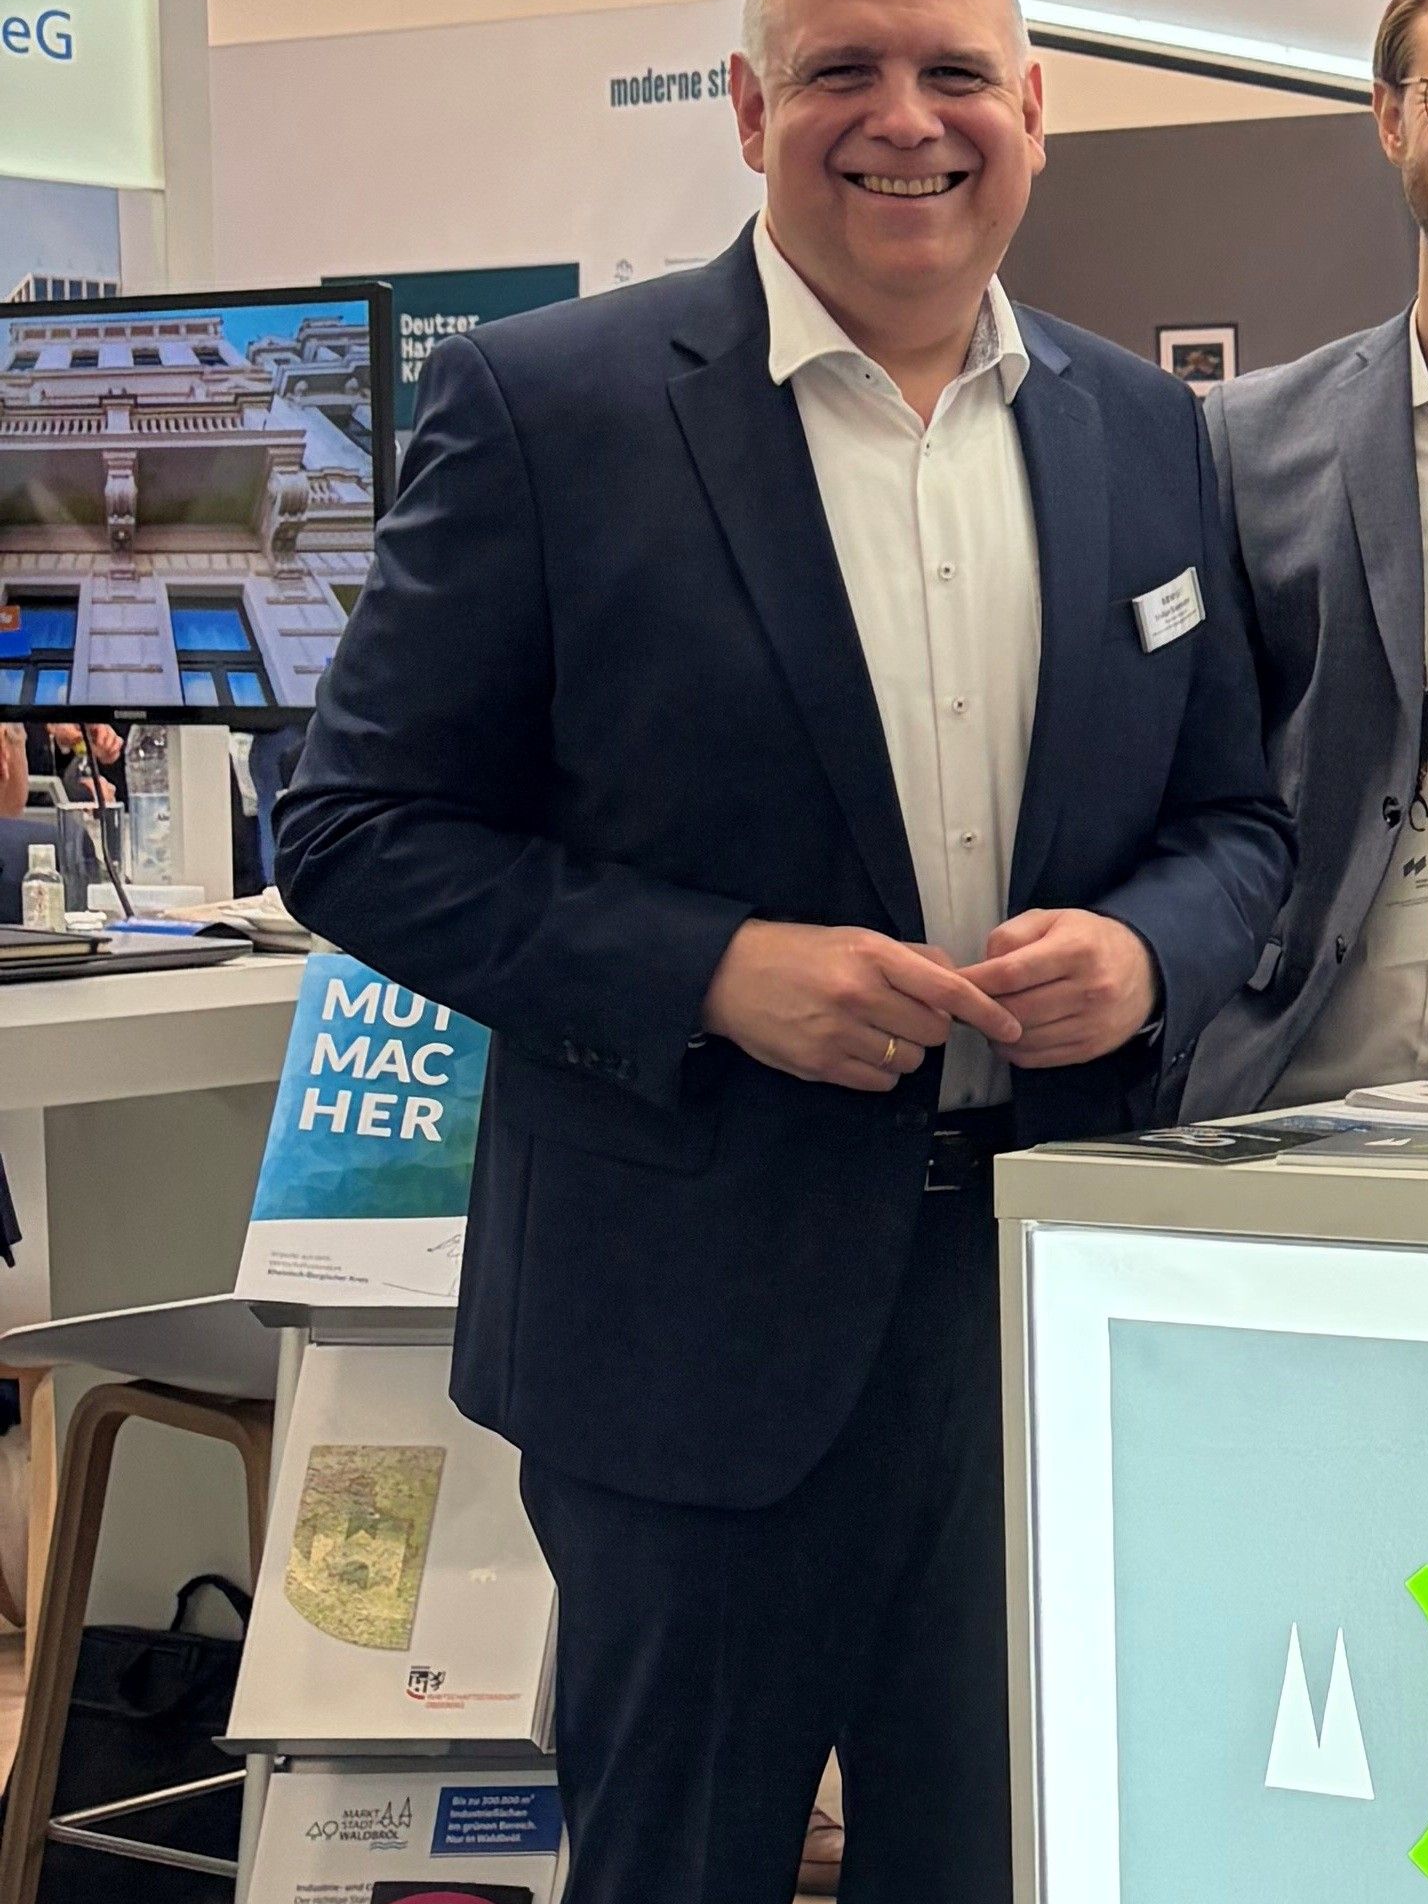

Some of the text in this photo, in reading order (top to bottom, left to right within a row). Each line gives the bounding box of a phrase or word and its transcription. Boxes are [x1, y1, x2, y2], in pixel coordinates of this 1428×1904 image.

[2, 9, 74, 62] eG
[610, 60, 732, 108] moderne st
[400, 312, 479, 336] Deutzer
[310, 1032, 455, 1087] MAC
[298, 1087, 444, 1142] HER
